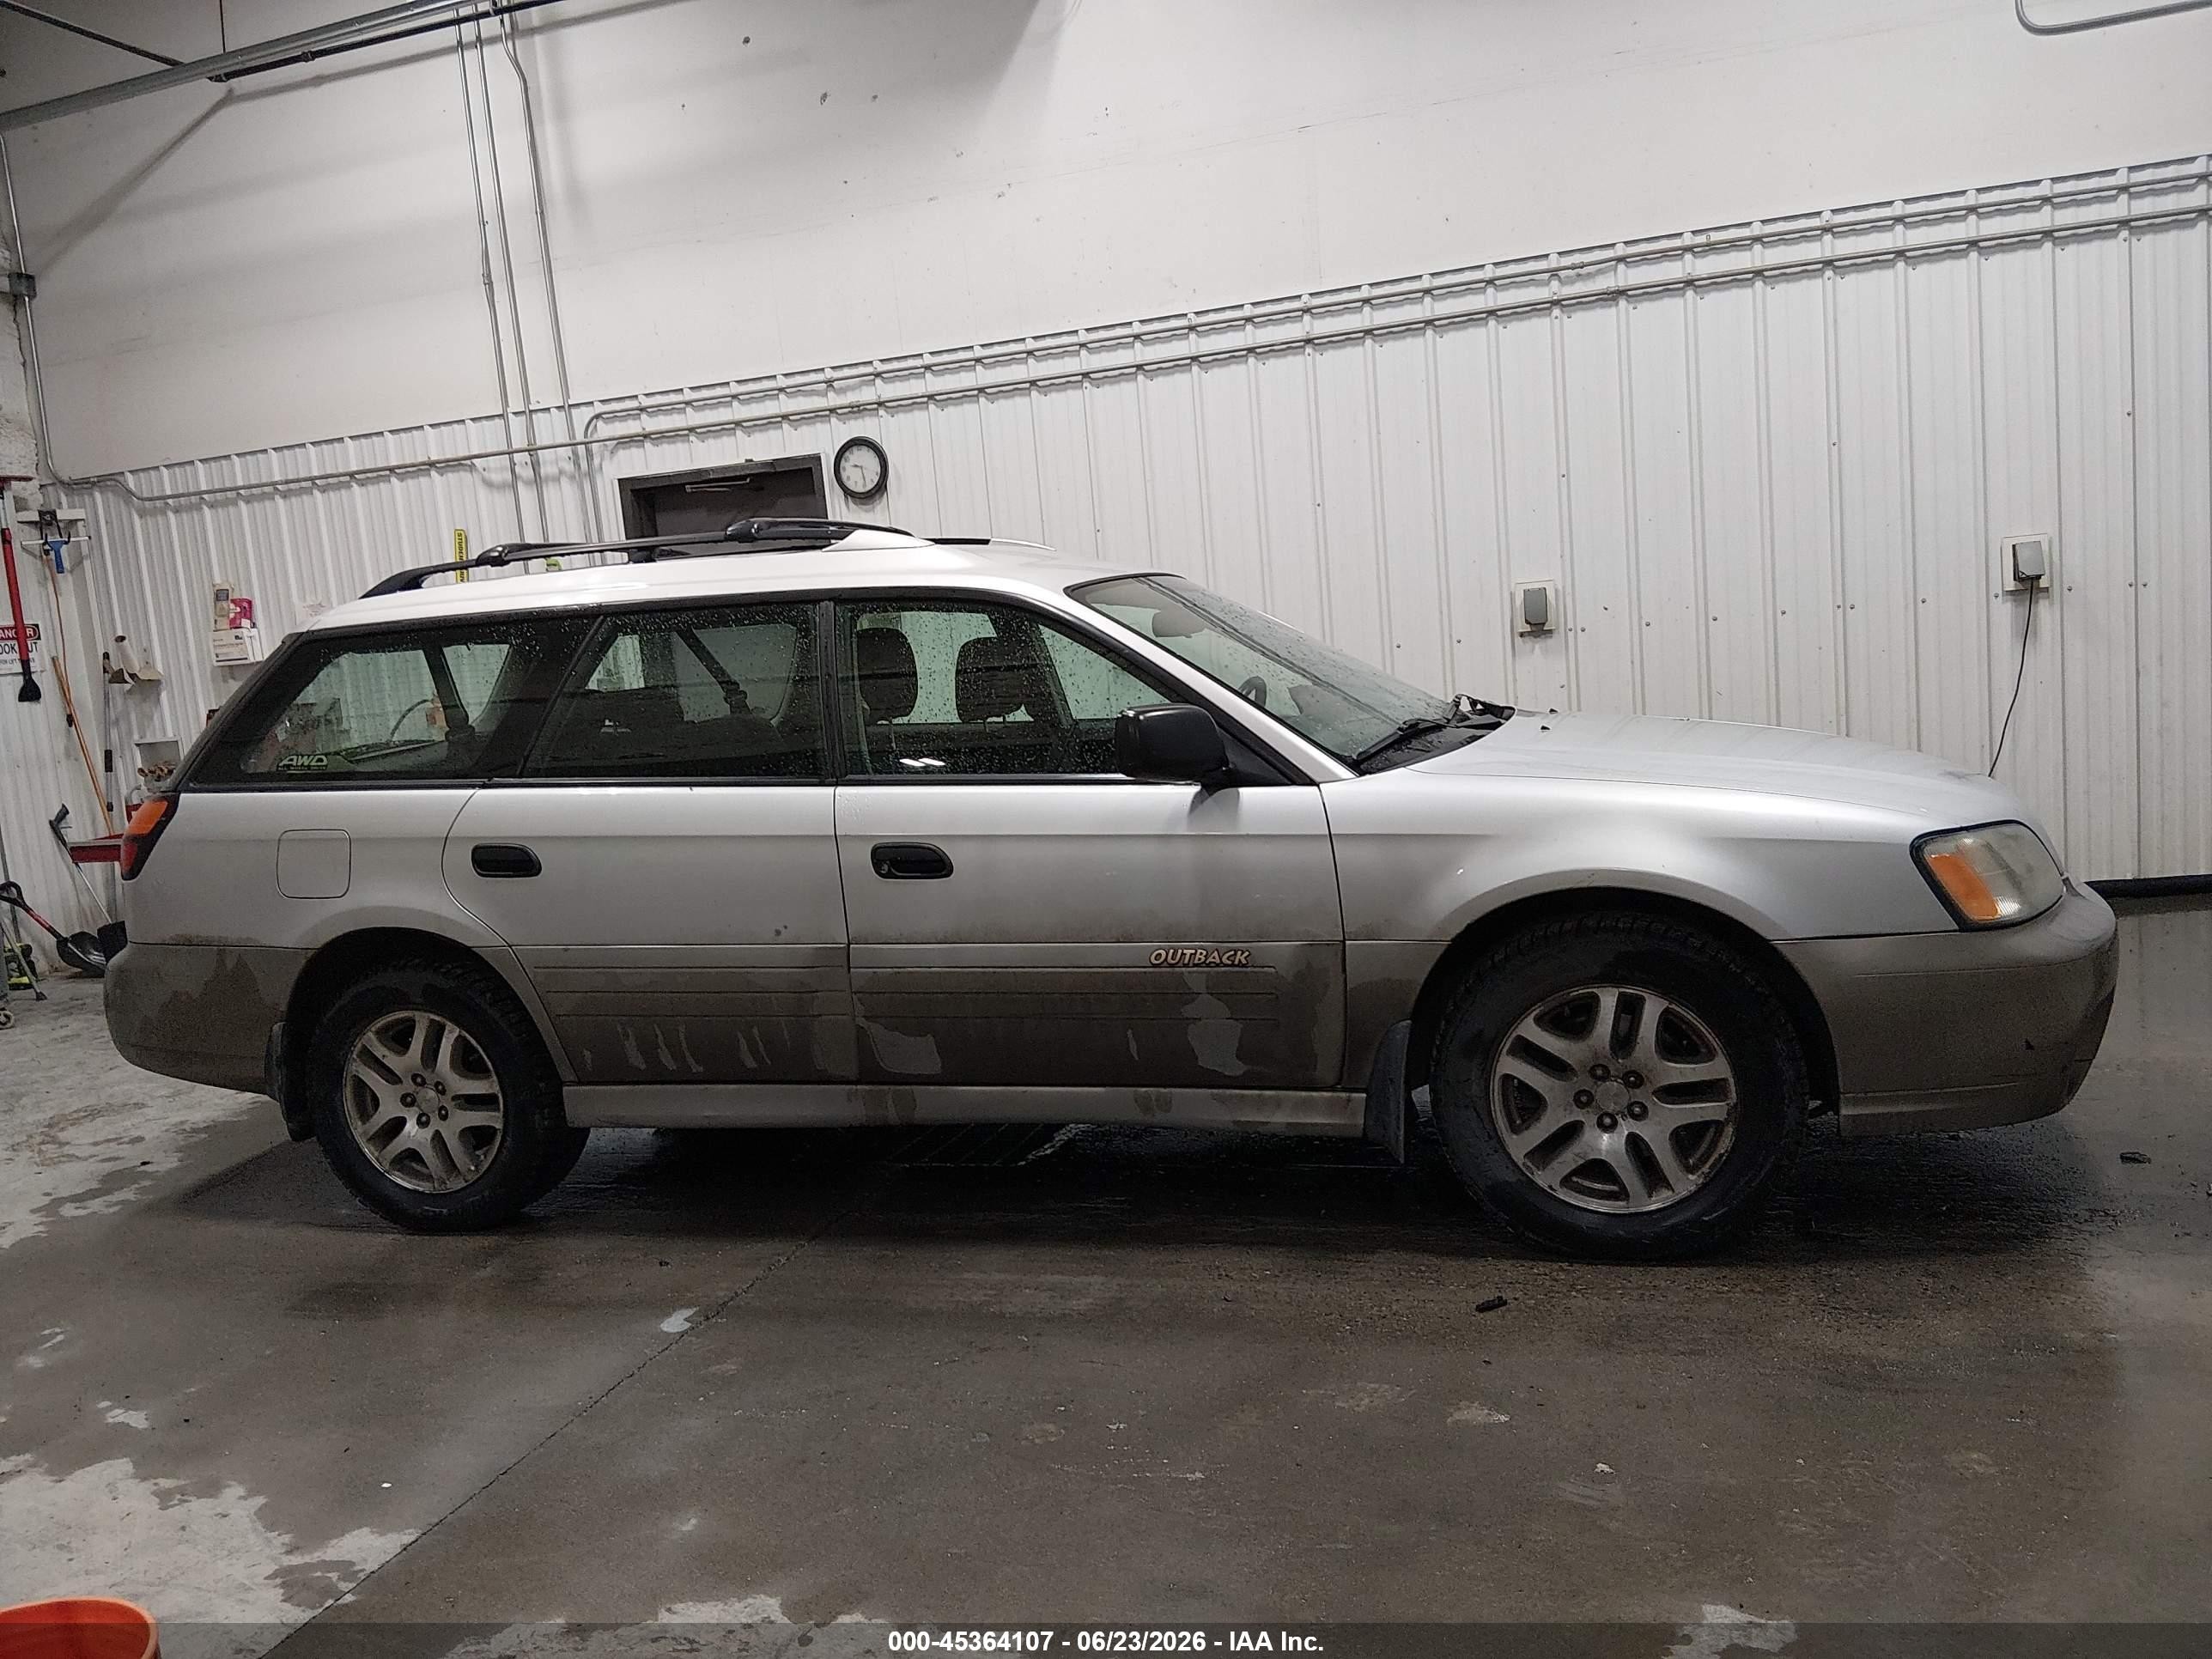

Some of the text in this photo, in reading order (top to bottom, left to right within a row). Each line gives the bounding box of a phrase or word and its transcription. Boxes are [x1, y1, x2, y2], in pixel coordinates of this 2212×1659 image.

[0, 628, 34, 639] ANGR
[278, 755, 328, 766] AWD
[1150, 948, 1250, 965] OUTBACK
